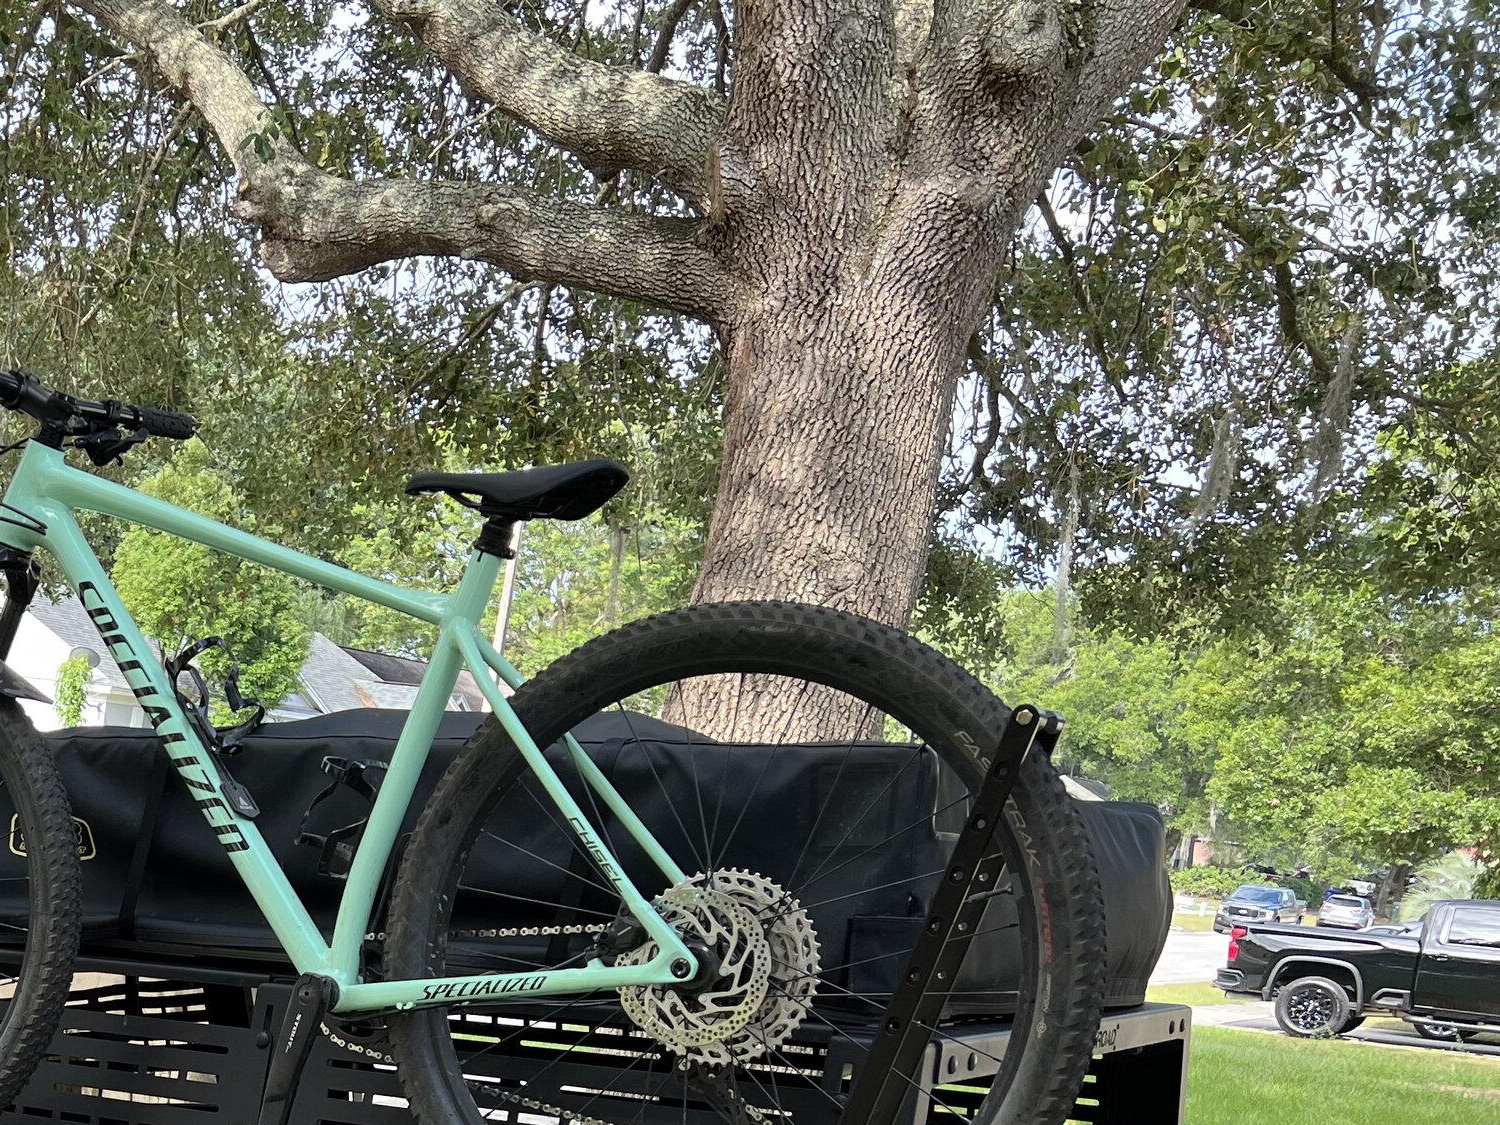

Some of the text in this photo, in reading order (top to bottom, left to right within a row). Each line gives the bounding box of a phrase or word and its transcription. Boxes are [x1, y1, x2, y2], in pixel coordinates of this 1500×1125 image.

[79, 581, 249, 851] SPECIALIZED
[954, 730, 992, 773] FAS
[568, 817, 622, 893] CHISEL
[417, 976, 548, 1001] SPECIALIZED
